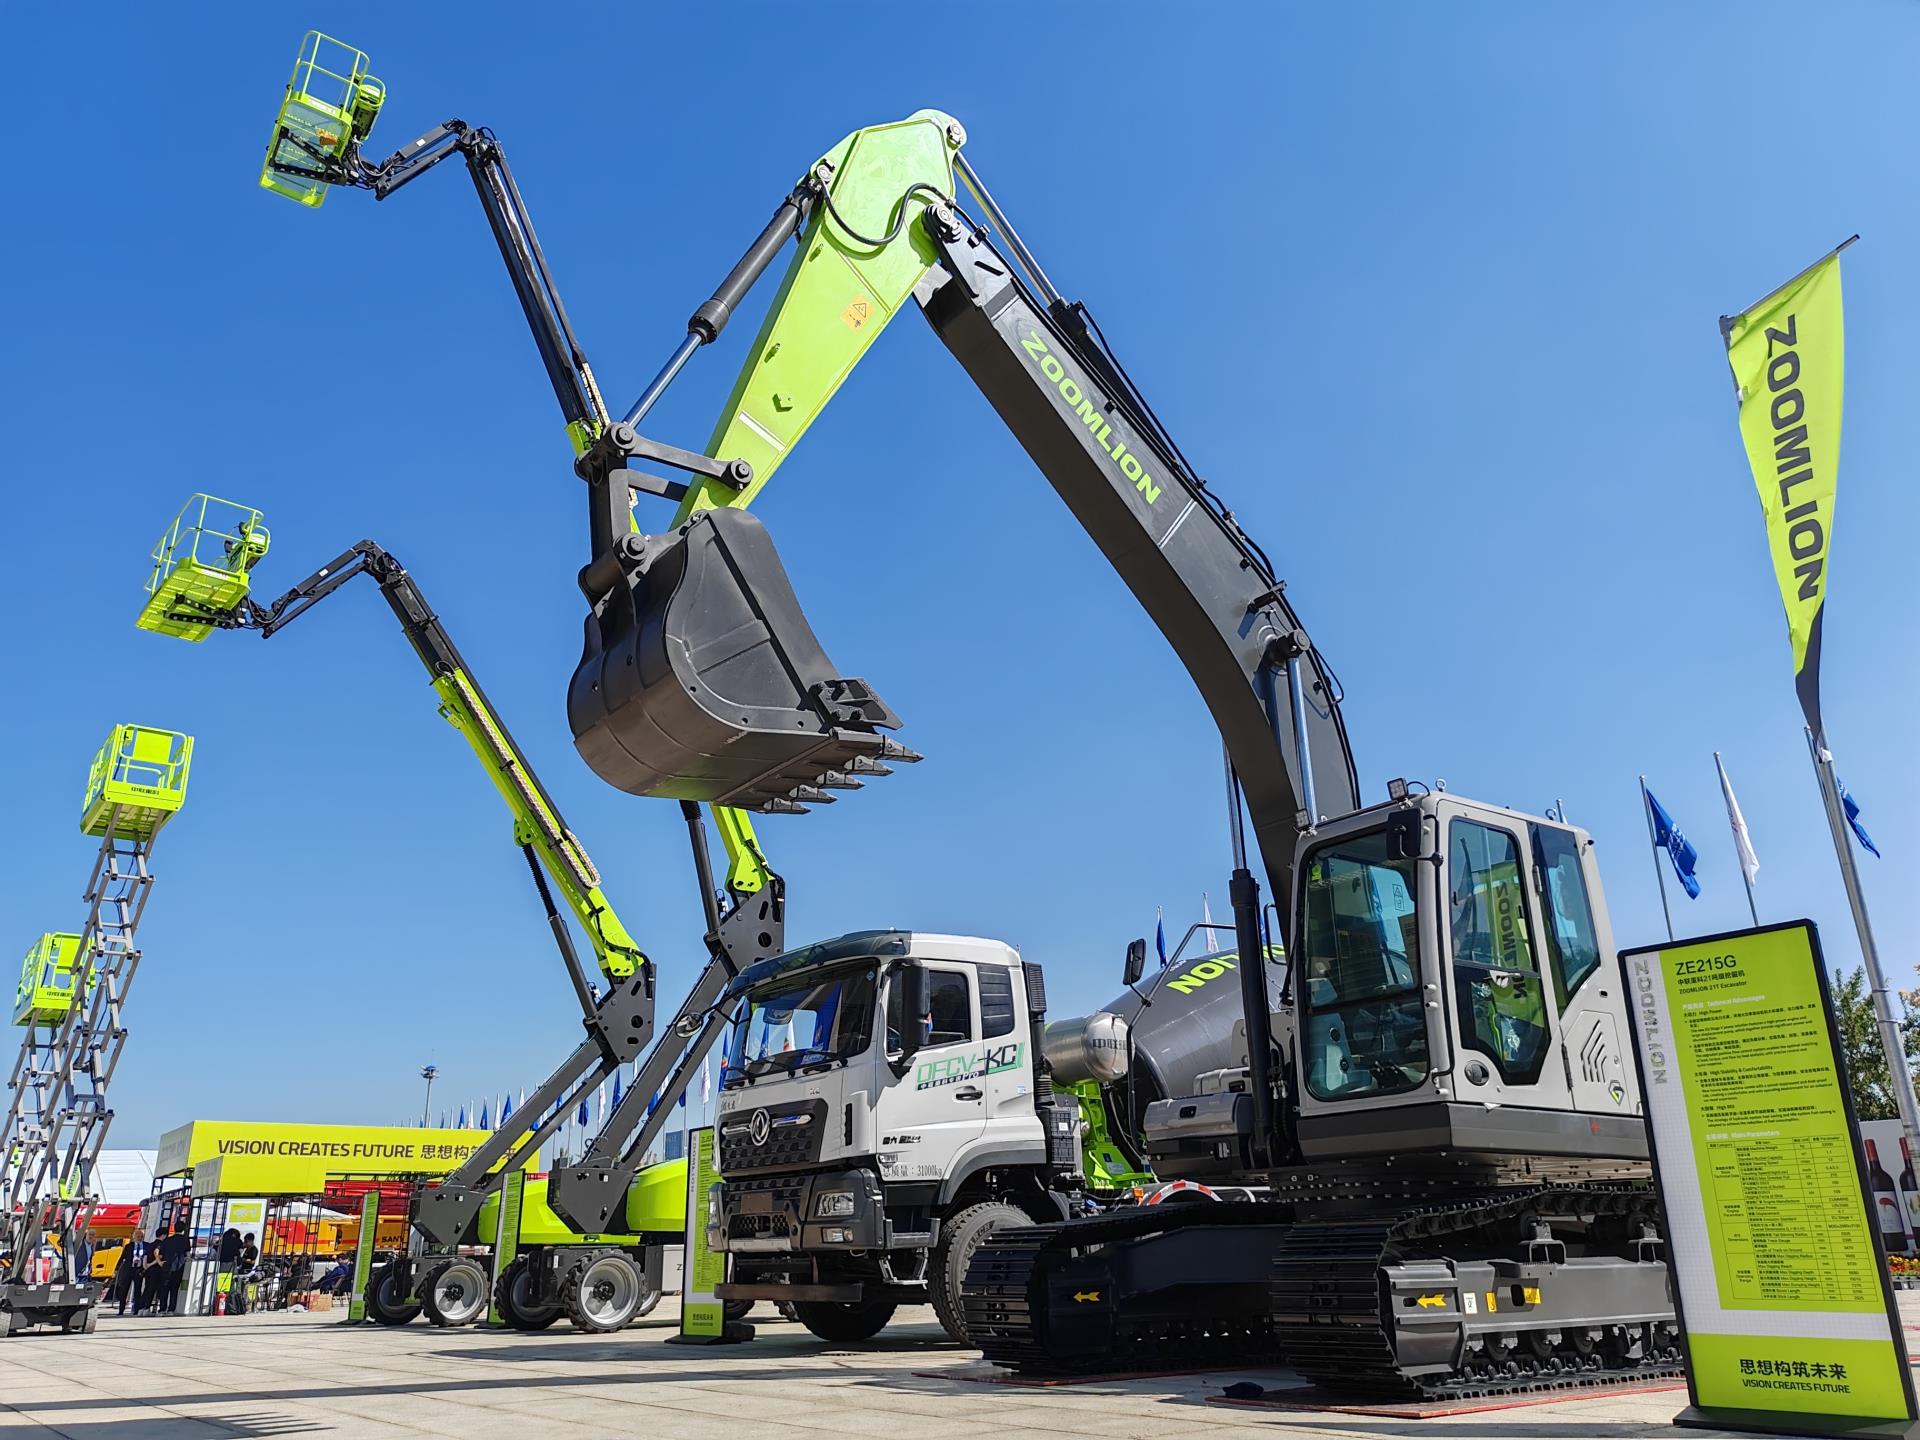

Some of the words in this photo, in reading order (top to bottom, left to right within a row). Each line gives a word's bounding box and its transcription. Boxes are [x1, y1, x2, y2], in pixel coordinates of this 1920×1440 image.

[1019, 330, 1161, 505] ZOOMLION
[1765, 314, 1825, 602] ZOOMLION
[1675, 954, 1737, 975] ZE215G
[1633, 960, 1668, 1085] ZOOMLION
[218, 1140, 276, 1154] VISION
[278, 1141, 350, 1156] CREATES
[354, 1144, 414, 1158] FUTURE
[1740, 1359, 1847, 1380] 思想构筑未来
[1742, 1379, 1772, 1388] VISION
[1773, 1380, 1812, 1391] CREATES
[1814, 1384, 1851, 1393] FUTURE
